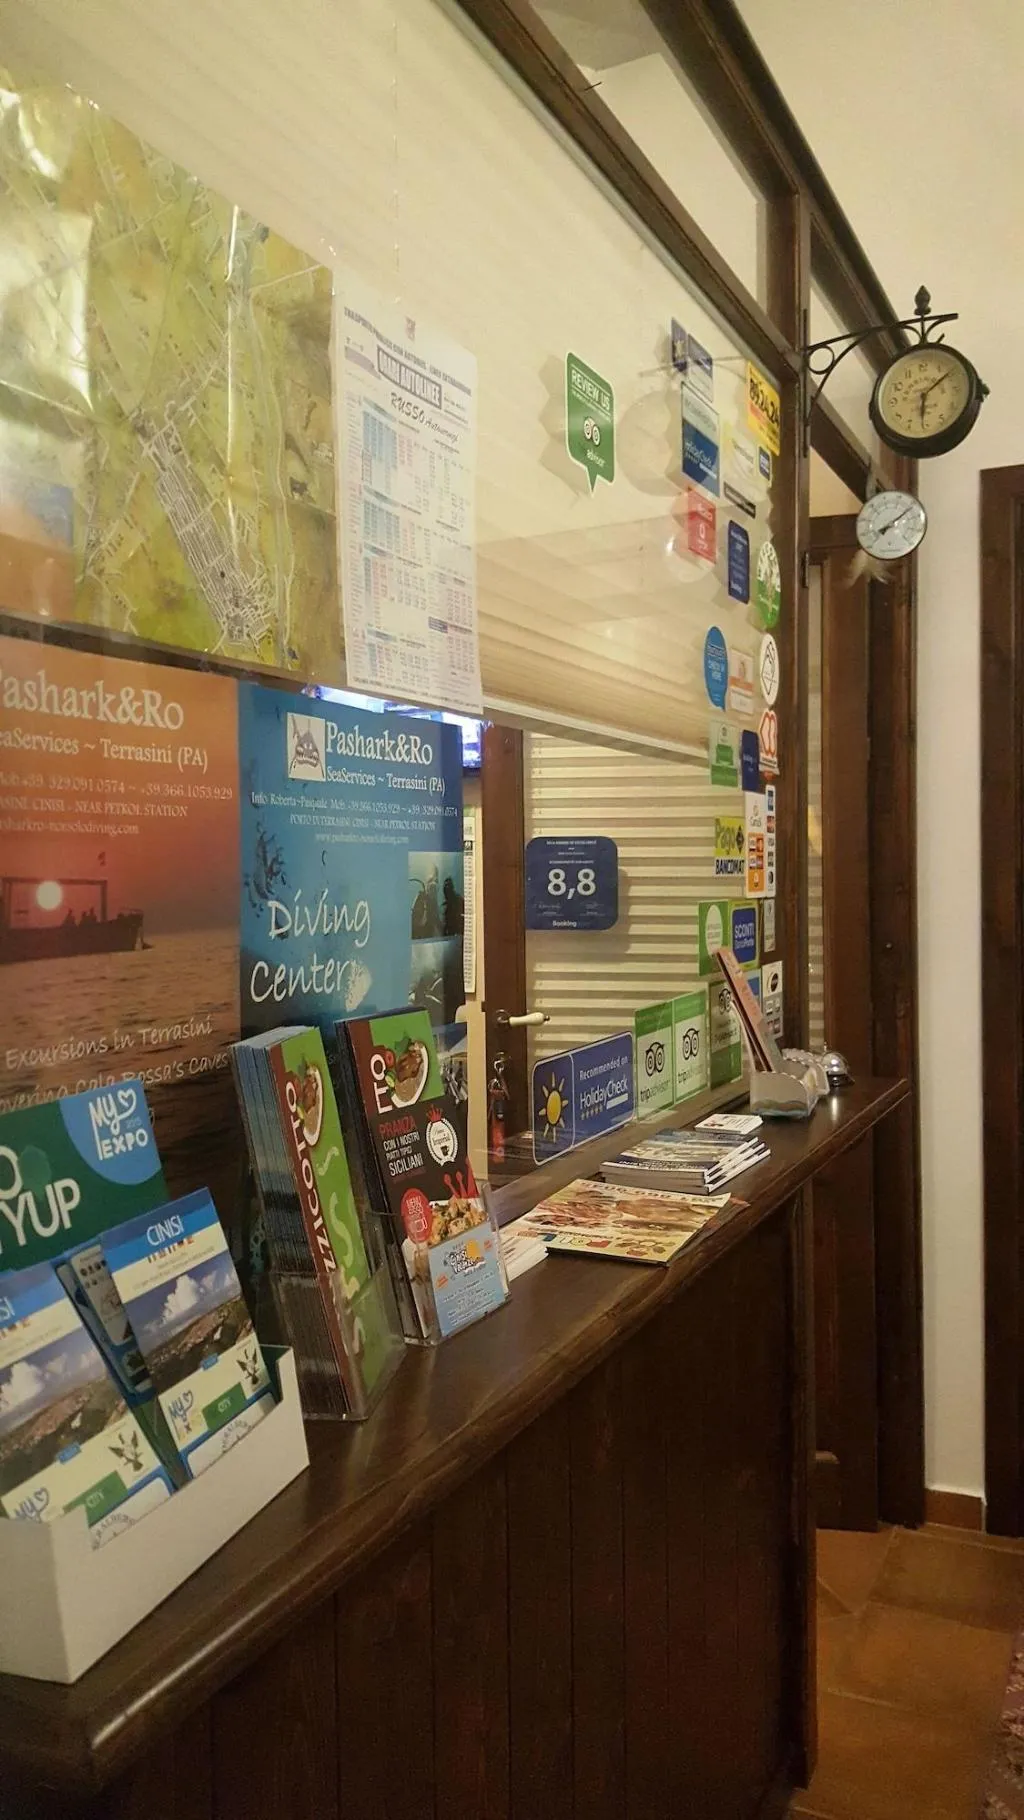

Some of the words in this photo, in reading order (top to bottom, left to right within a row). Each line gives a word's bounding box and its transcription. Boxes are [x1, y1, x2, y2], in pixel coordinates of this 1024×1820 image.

[571, 369, 599, 402] REVIEW
[600, 391, 611, 411] US
[0, 669, 185, 730] ashark&Ro
[99, 737, 173, 765] Terrasini
[177, 746, 209, 774] (PA)
[326, 720, 433, 766] Pashark&Ro
[326, 766, 376, 787] SeaServices
[386, 773, 428, 791] Terrasini
[429, 775, 446, 797] (PA)
[547, 868, 597, 900] 8,8
[267, 888, 371, 947] Diving
[552, 920, 577, 928] Booking
[250, 953, 349, 1003] Center
[4, 1037, 107, 1069] Excursions
[113, 1031, 135, 1051] in
[139, 1017, 213, 1045] Terrasini
[188, 1051, 229, 1075] Caves
[579, 1059, 615, 1081] Recommended
[616, 1055, 629, 1068] on
[579, 1077, 629, 1110] HolidayCheck
[378, 1114, 418, 1139] PRANZA
[383, 1138, 397, 1151] CON
[400, 1131, 421, 1146] NOSTRI
[101, 1128, 149, 1160] EXPO
[388, 1152, 424, 1177] SICILIANI
[146, 1215, 185, 1246] CINISI
